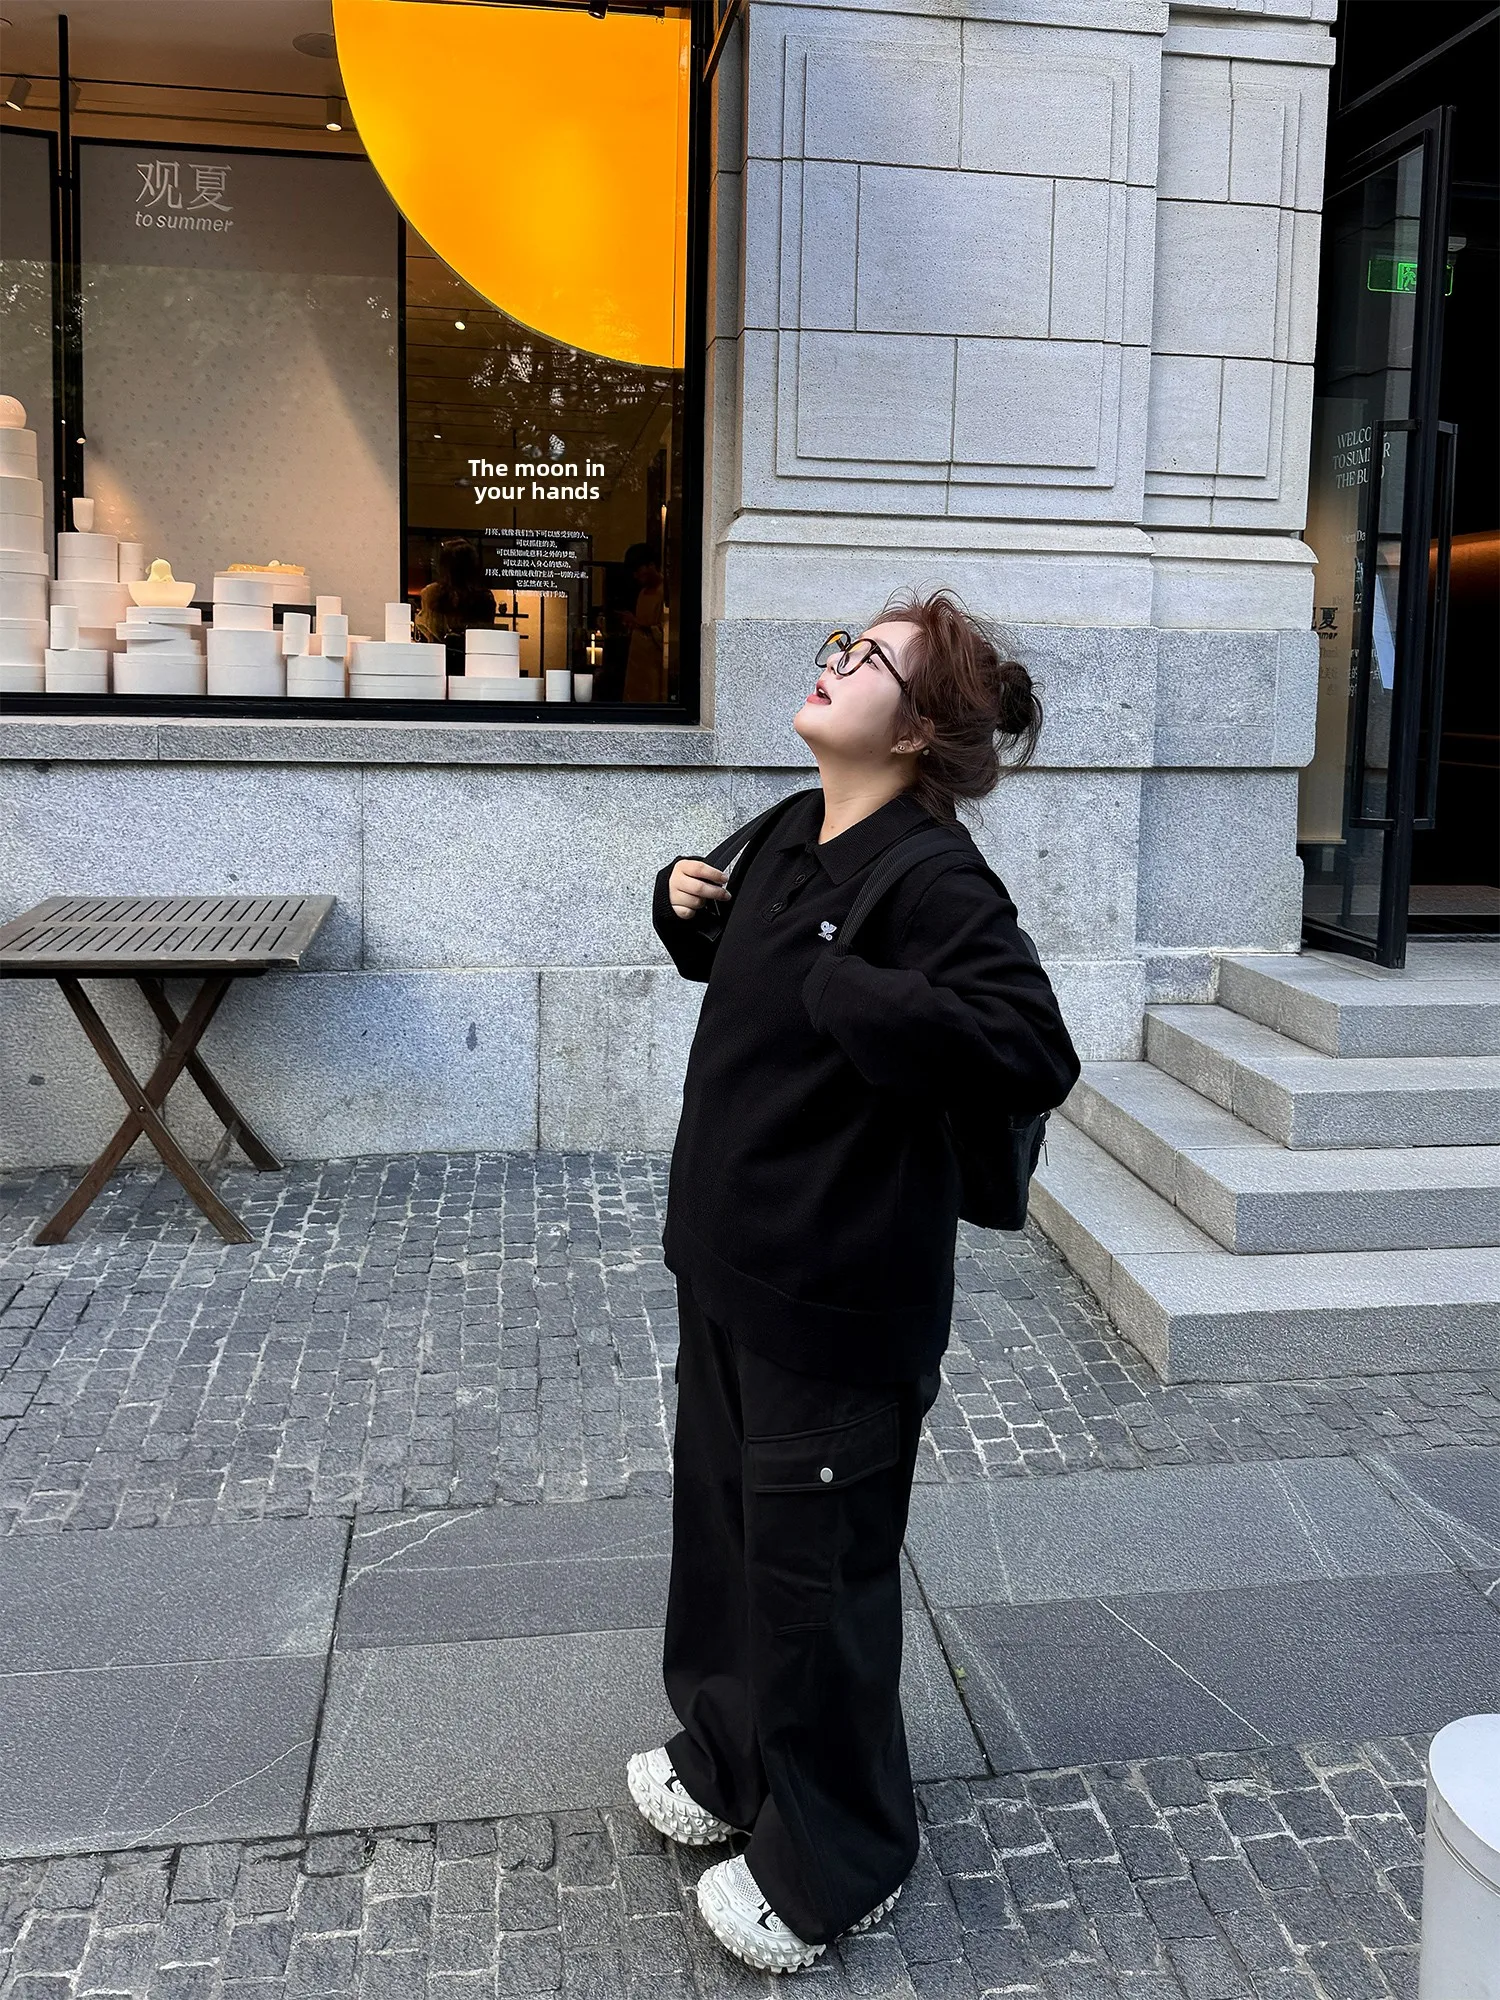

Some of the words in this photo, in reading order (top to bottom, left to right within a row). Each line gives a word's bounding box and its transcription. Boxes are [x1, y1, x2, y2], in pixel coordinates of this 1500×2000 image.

[135, 160, 234, 213] 观夏
[135, 211, 153, 228] to
[156, 215, 234, 233] summer
[1337, 426, 1388, 449] WELCO
[1333, 453, 1346, 470] TO
[1346, 441, 1391, 467] SUMR
[1336, 470, 1356, 489] THE
